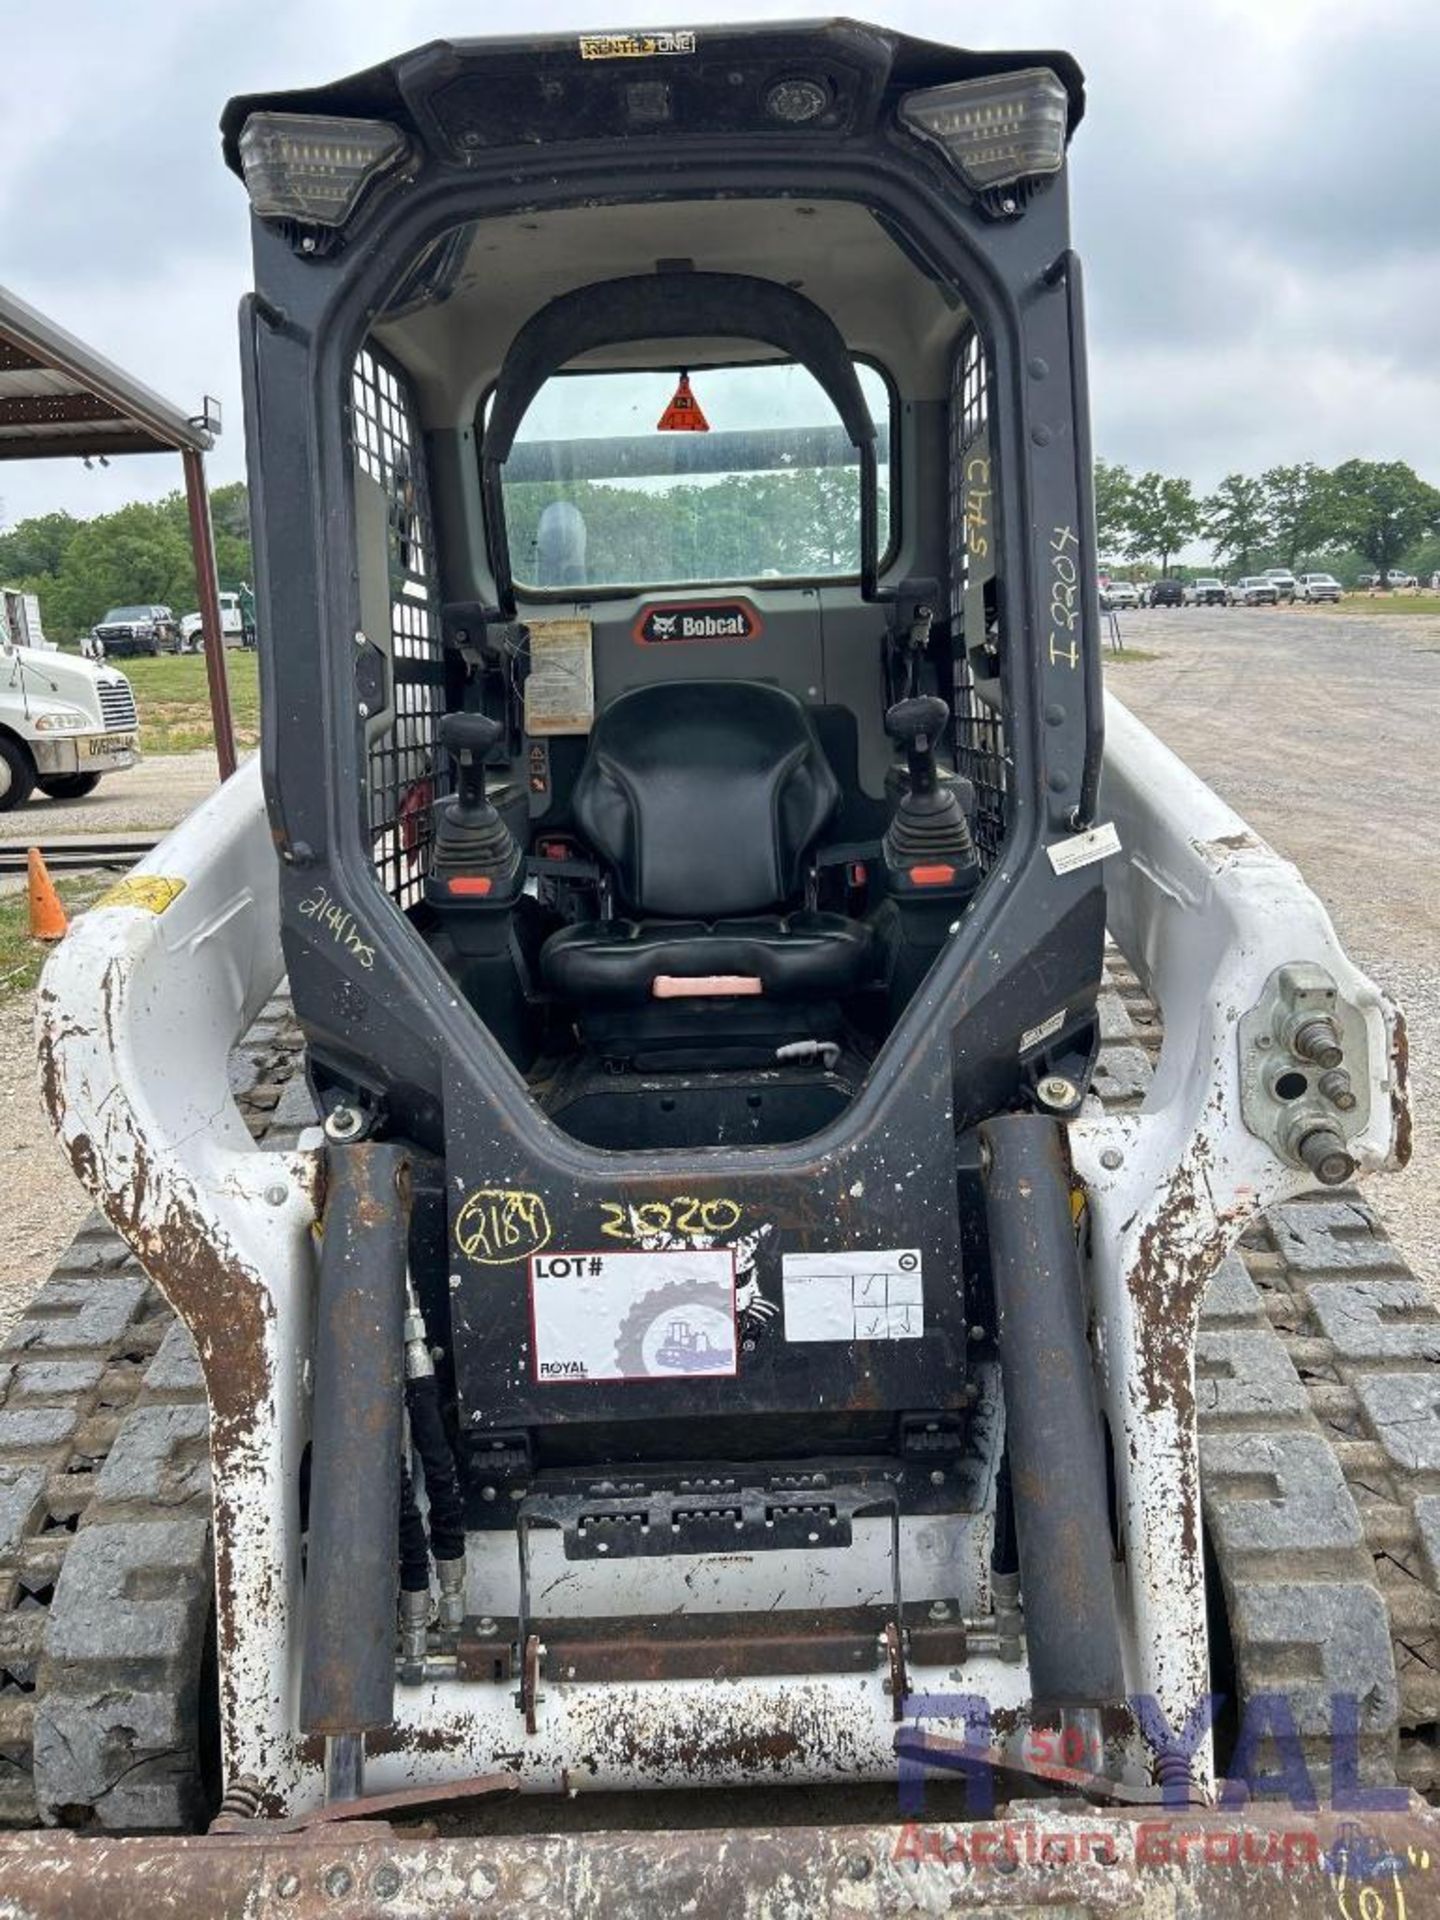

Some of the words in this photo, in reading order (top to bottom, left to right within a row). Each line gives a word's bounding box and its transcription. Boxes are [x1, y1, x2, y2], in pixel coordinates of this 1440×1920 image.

[585, 38, 654, 56] RENT
[683, 614, 745, 637] Bobcat
[535, 1257, 604, 1279] LOT#
[540, 1360, 589, 1374] ROYAL
